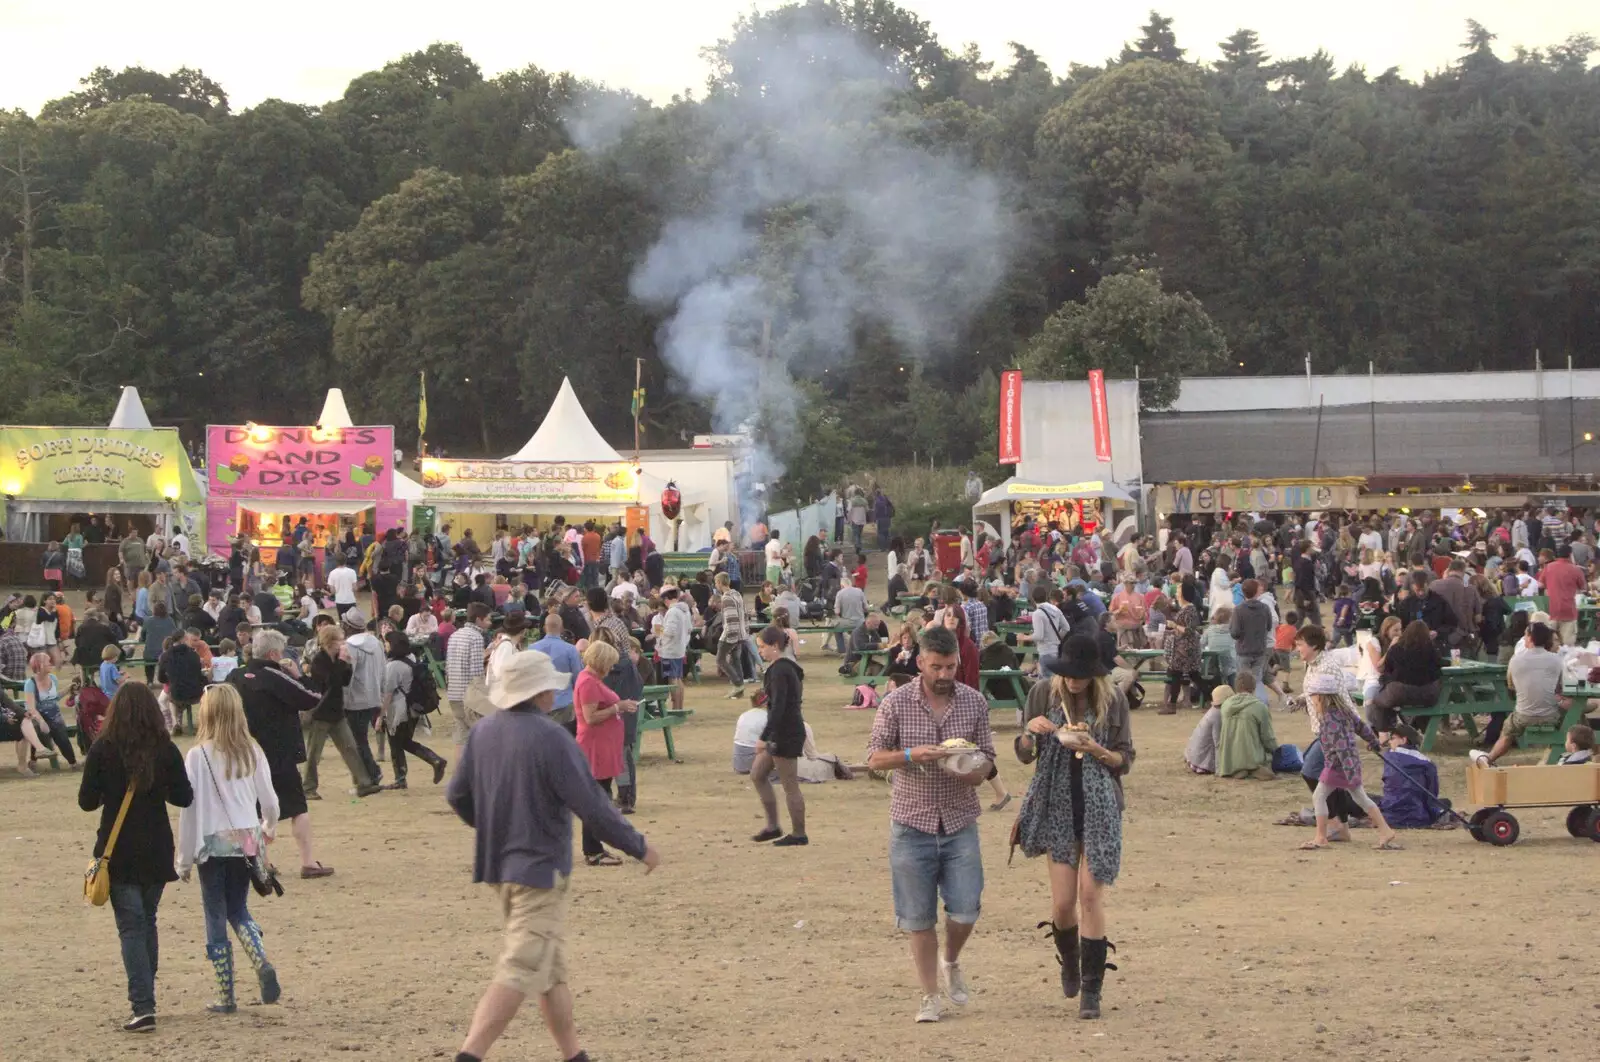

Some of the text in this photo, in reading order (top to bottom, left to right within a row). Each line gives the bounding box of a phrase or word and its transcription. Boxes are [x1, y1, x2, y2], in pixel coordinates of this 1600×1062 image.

[224, 429, 377, 445] DONUTS
[16, 437, 164, 469] SOFT DRINKS
[259, 450, 341, 465] AND
[259, 470, 342, 486] DIPS
